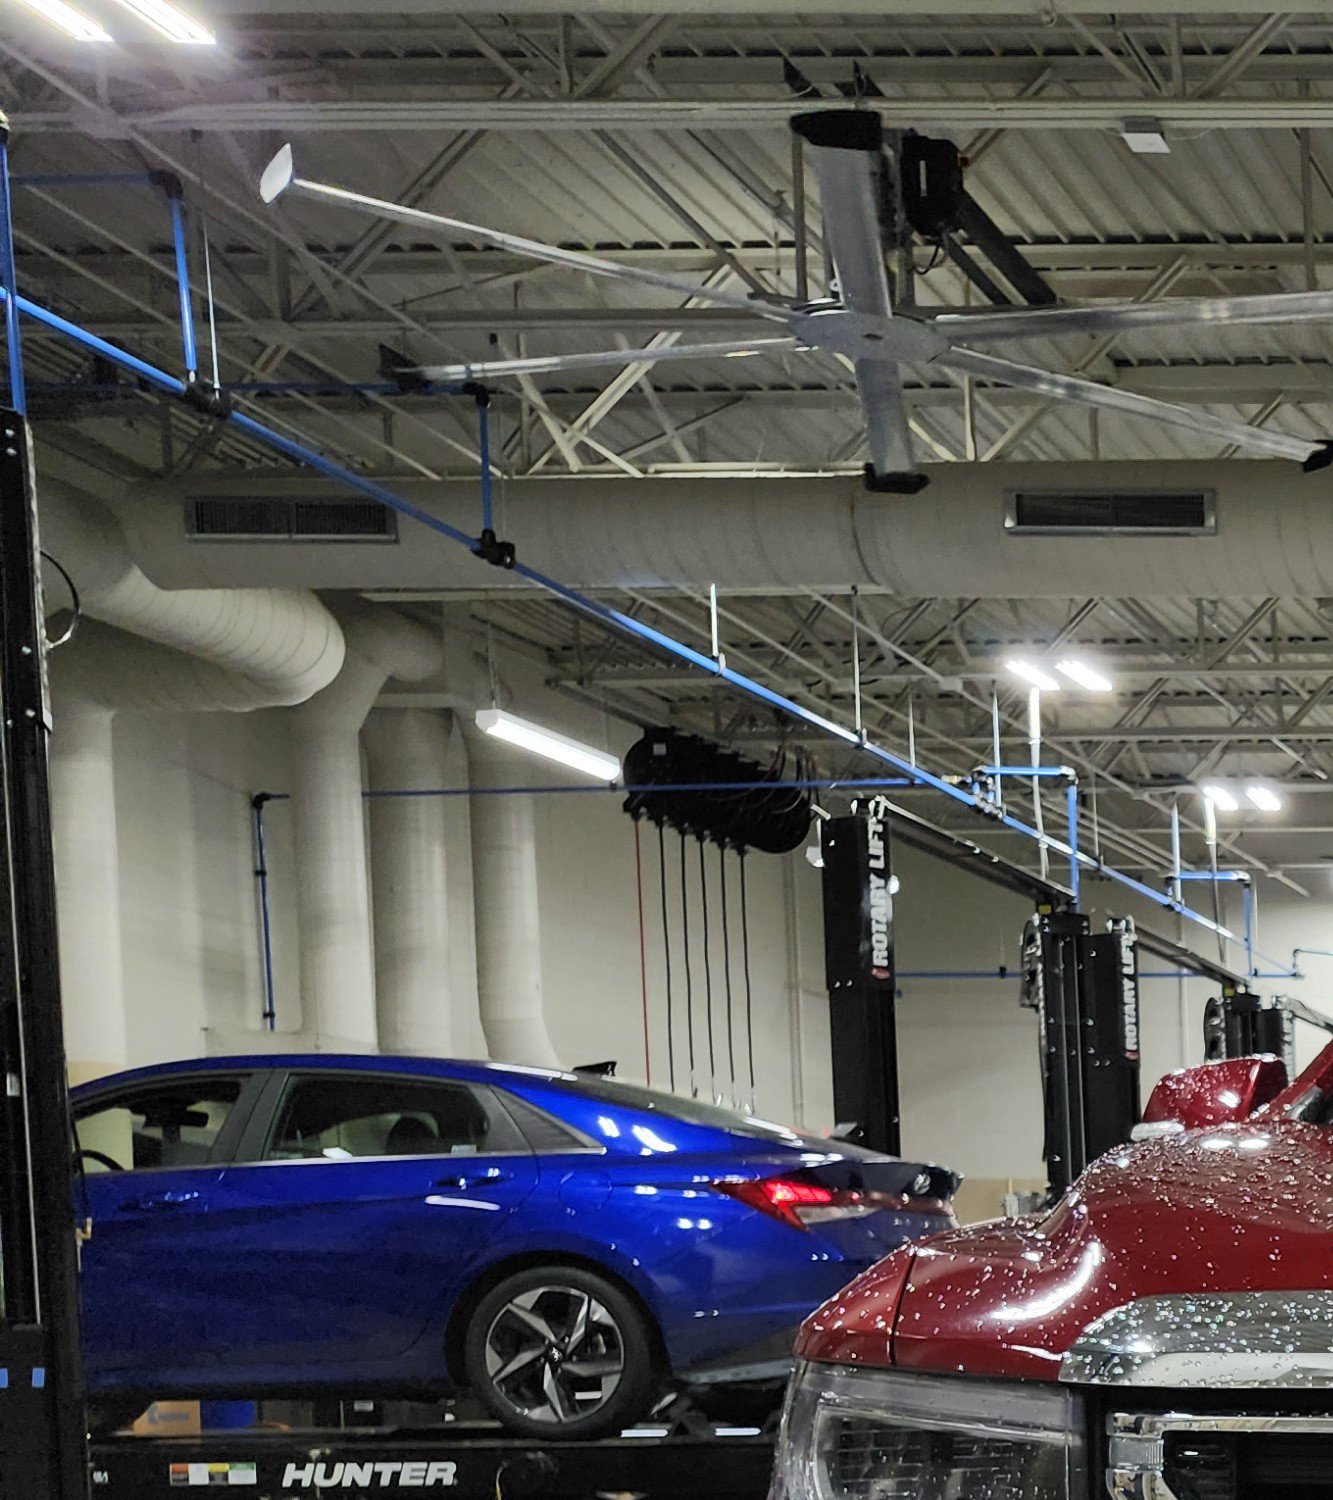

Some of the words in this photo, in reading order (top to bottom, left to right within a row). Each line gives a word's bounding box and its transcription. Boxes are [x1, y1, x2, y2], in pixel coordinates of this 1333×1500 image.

[868, 820, 886, 870] LIFT
[870, 874, 889, 967] ROTARY
[1123, 977, 1138, 1050] ROTARY
[282, 1462, 457, 1488] HUNTER
